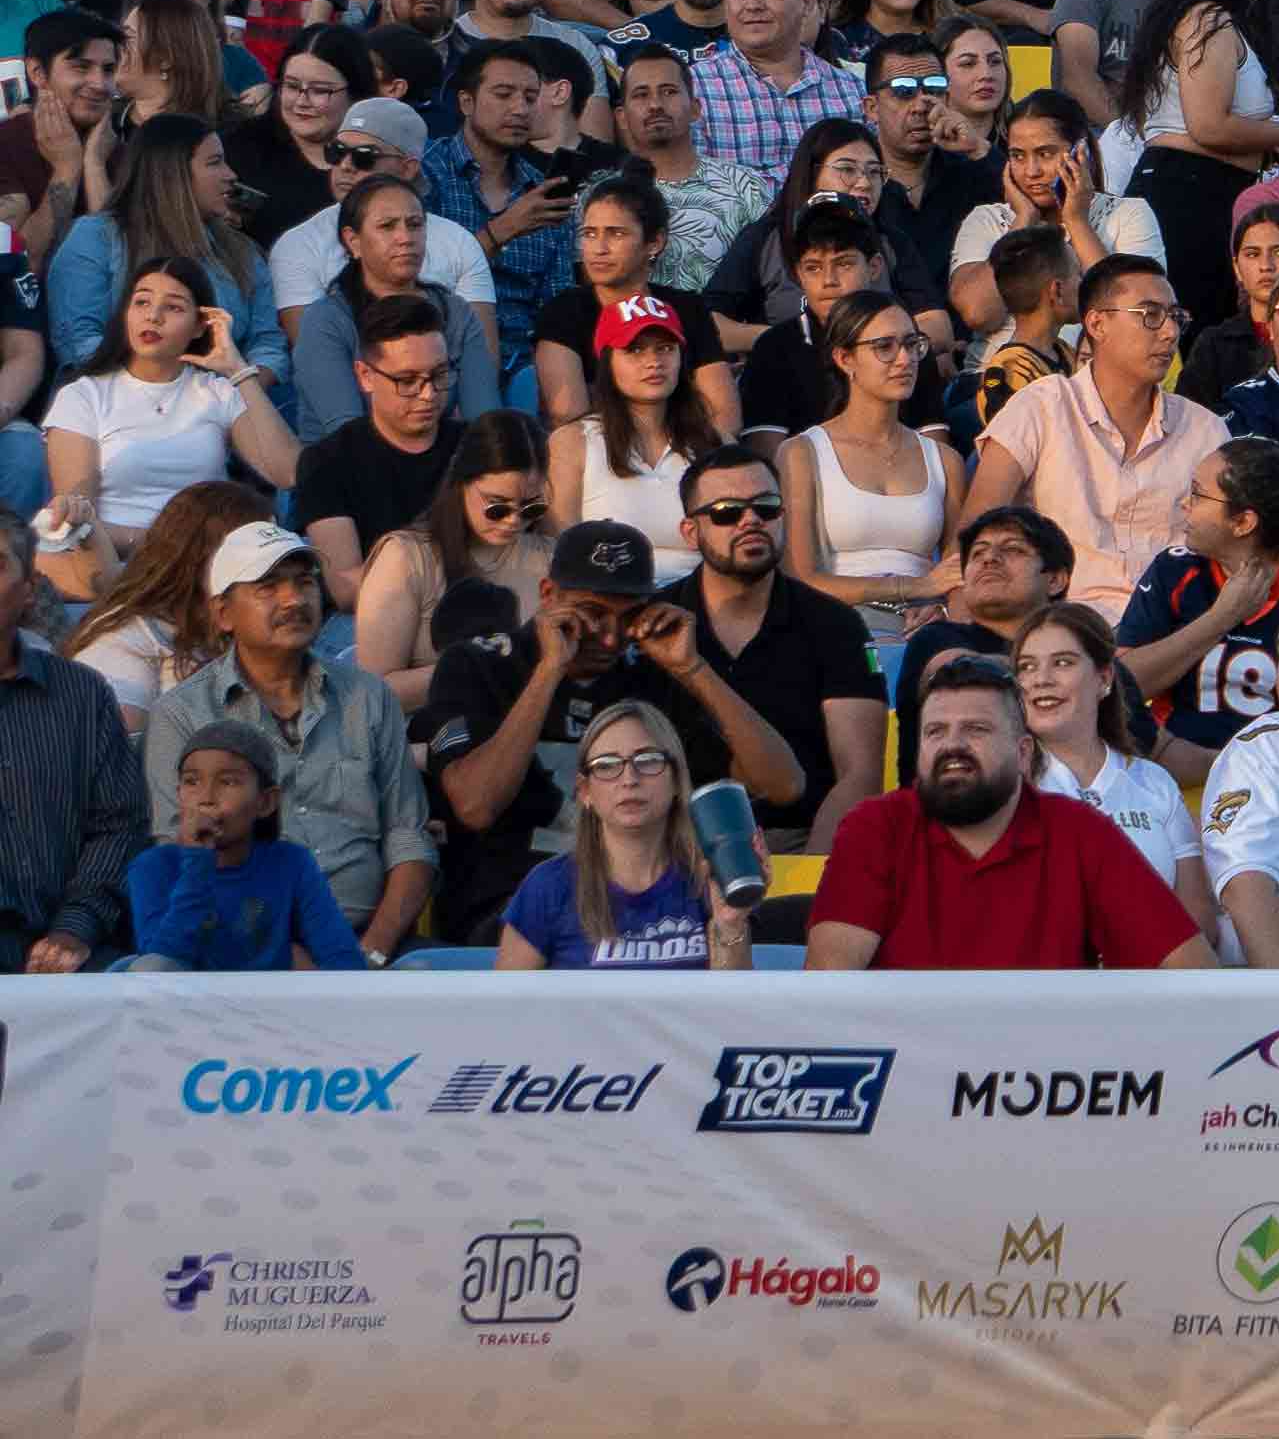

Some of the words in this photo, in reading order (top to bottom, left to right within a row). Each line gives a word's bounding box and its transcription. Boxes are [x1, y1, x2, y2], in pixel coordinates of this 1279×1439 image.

[617, 295, 668, 322] KC
[182, 1051, 421, 1114] Comex
[735, 1054, 812, 1087] TOP
[491, 1063, 665, 1113] telcel
[230, 1259, 354, 1281] CHRISTUS
[460, 1235, 583, 1324] alpha
[728, 1254, 881, 1307] Hágalo
[918, 1279, 1129, 1322] MASARYK
[223, 1311, 292, 1336] Hospital
[296, 1312, 327, 1331] Del
[330, 1311, 386, 1333] Parque
[477, 1332, 552, 1346] TRAVELS
[1172, 1314, 1223, 1336] BITA
